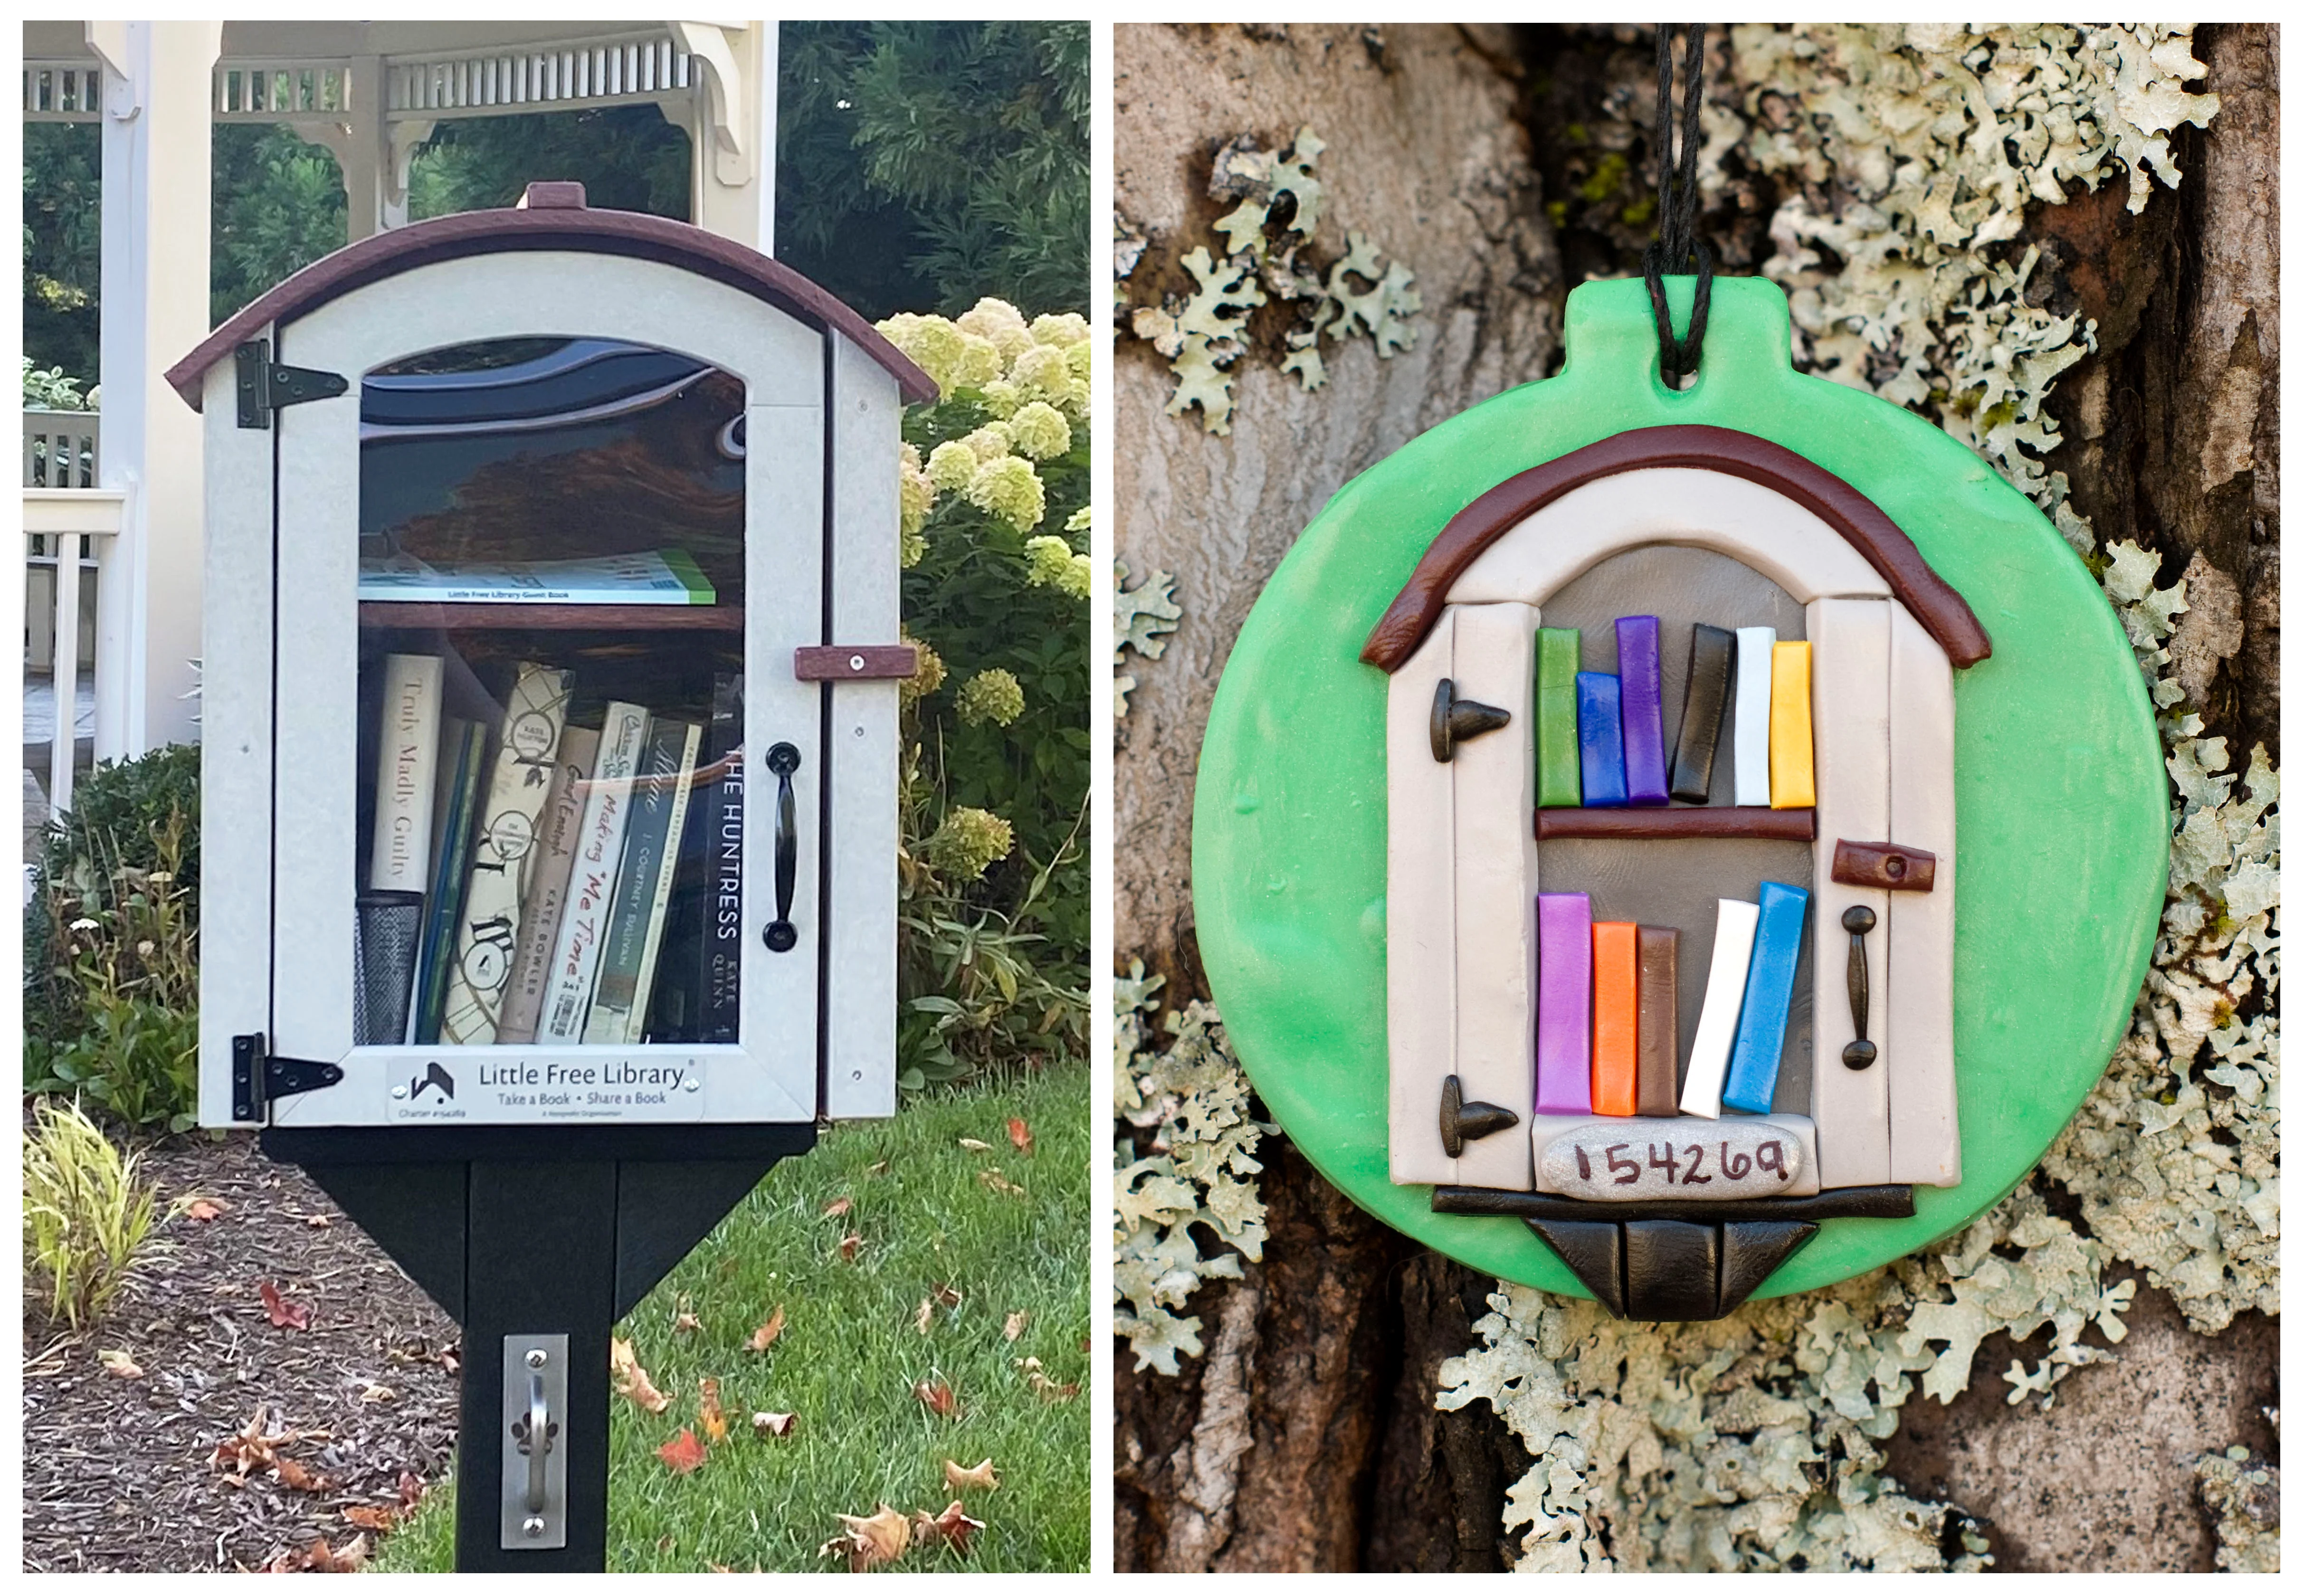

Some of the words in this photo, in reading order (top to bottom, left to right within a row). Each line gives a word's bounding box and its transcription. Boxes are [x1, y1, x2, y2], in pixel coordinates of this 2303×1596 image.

[491, 590, 520, 599] Library
[401, 677, 423, 734] Truly
[393, 744, 419, 803] Madly
[645, 738, 678, 816] Maine
[390, 815, 412, 880] Guilty
[586, 793, 617, 863] Making
[629, 847, 651, 909] COURTNEY
[717, 804, 742, 940] HUNTRESS
[541, 889, 556, 926] KATE
[527, 933, 548, 996] BOWLER
[713, 953, 725, 1010] QUINN
[727, 960, 737, 1003] KATE
[479, 1062, 539, 1086] Little
[547, 1064, 596, 1085] Free
[603, 1062, 684, 1090] Library
[498, 1092, 526, 1106] Take
[529, 1096, 536, 1105] a
[540, 1092, 571, 1105] Book
[587, 1092, 622, 1104] Share
[625, 1095, 632, 1104] a
[636, 1092, 666, 1104] Book
[1575, 1140, 1788, 1185] 154269
